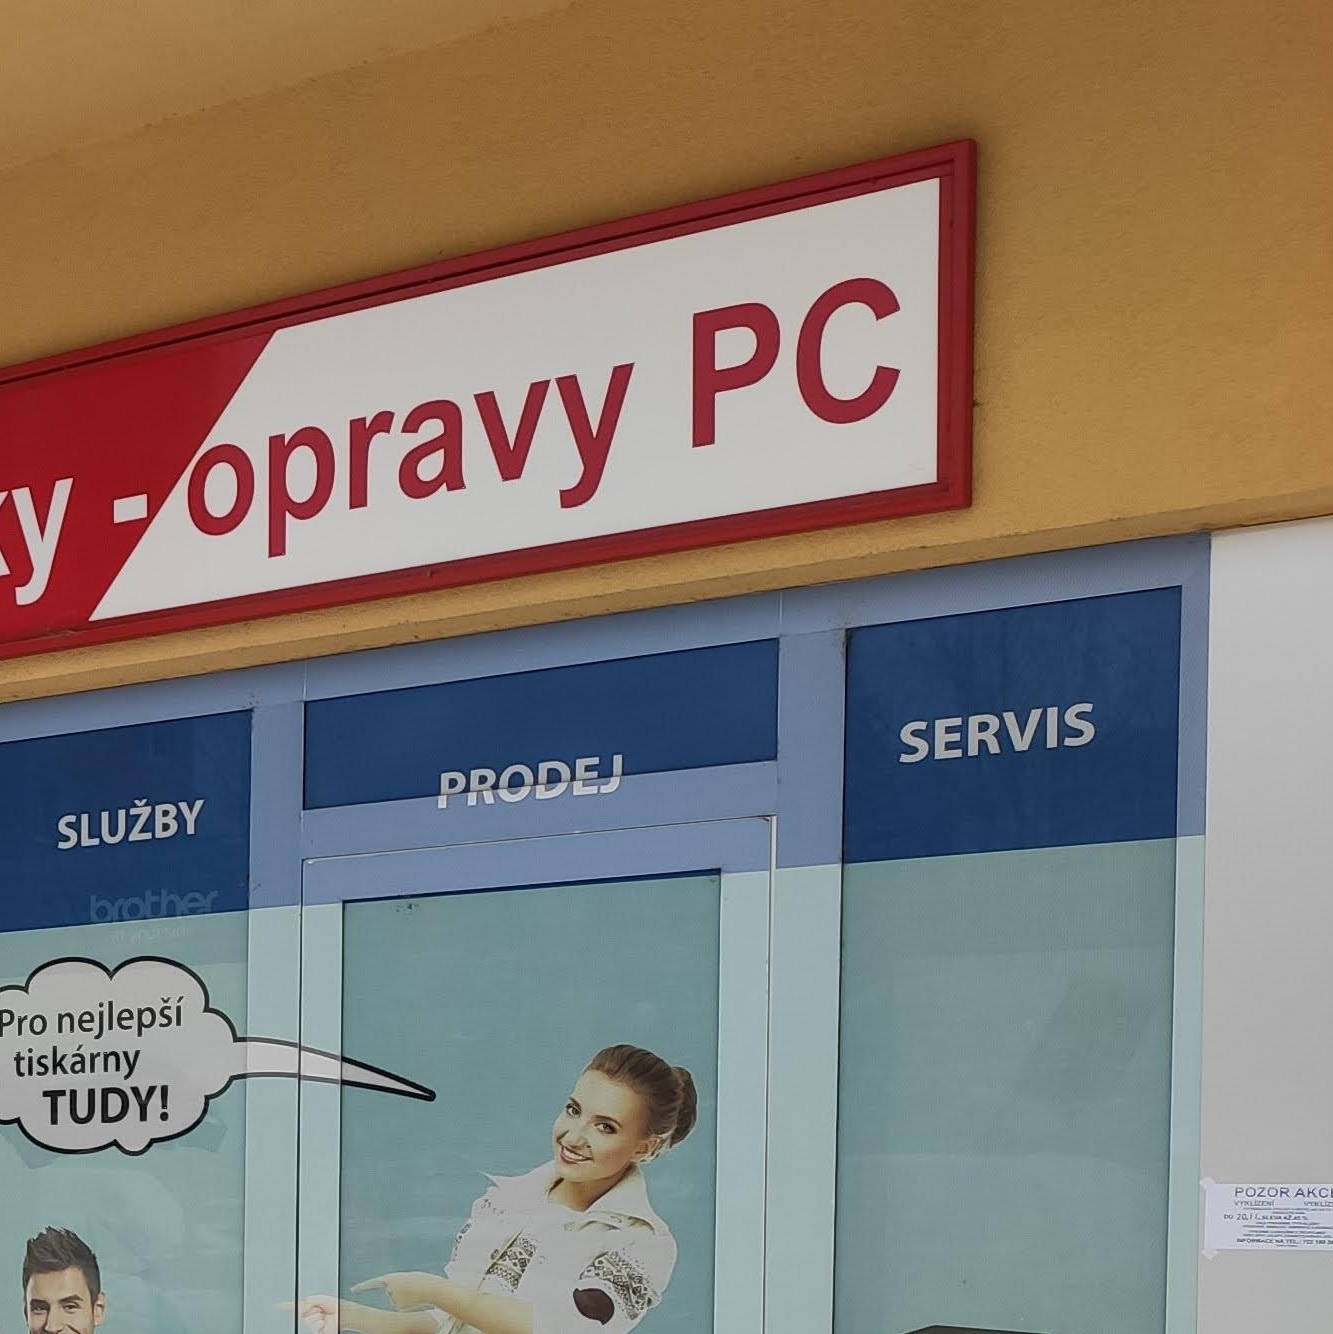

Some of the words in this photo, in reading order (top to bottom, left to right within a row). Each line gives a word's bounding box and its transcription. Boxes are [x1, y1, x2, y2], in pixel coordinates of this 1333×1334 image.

[187, 362, 636, 557] opravy
[690, 275, 903, 450] PC
[898, 702, 1096, 764] SERVIS
[437, 754, 624, 809] PRODEJ
[57, 799, 205, 849] SLUŽBY
[57, 996, 184, 1040] nejlepší
[14, 1044, 141, 1080] tiskárny
[42, 1084, 169, 1126] TUDY!
[1234, 1187, 1290, 1198] POZOR
